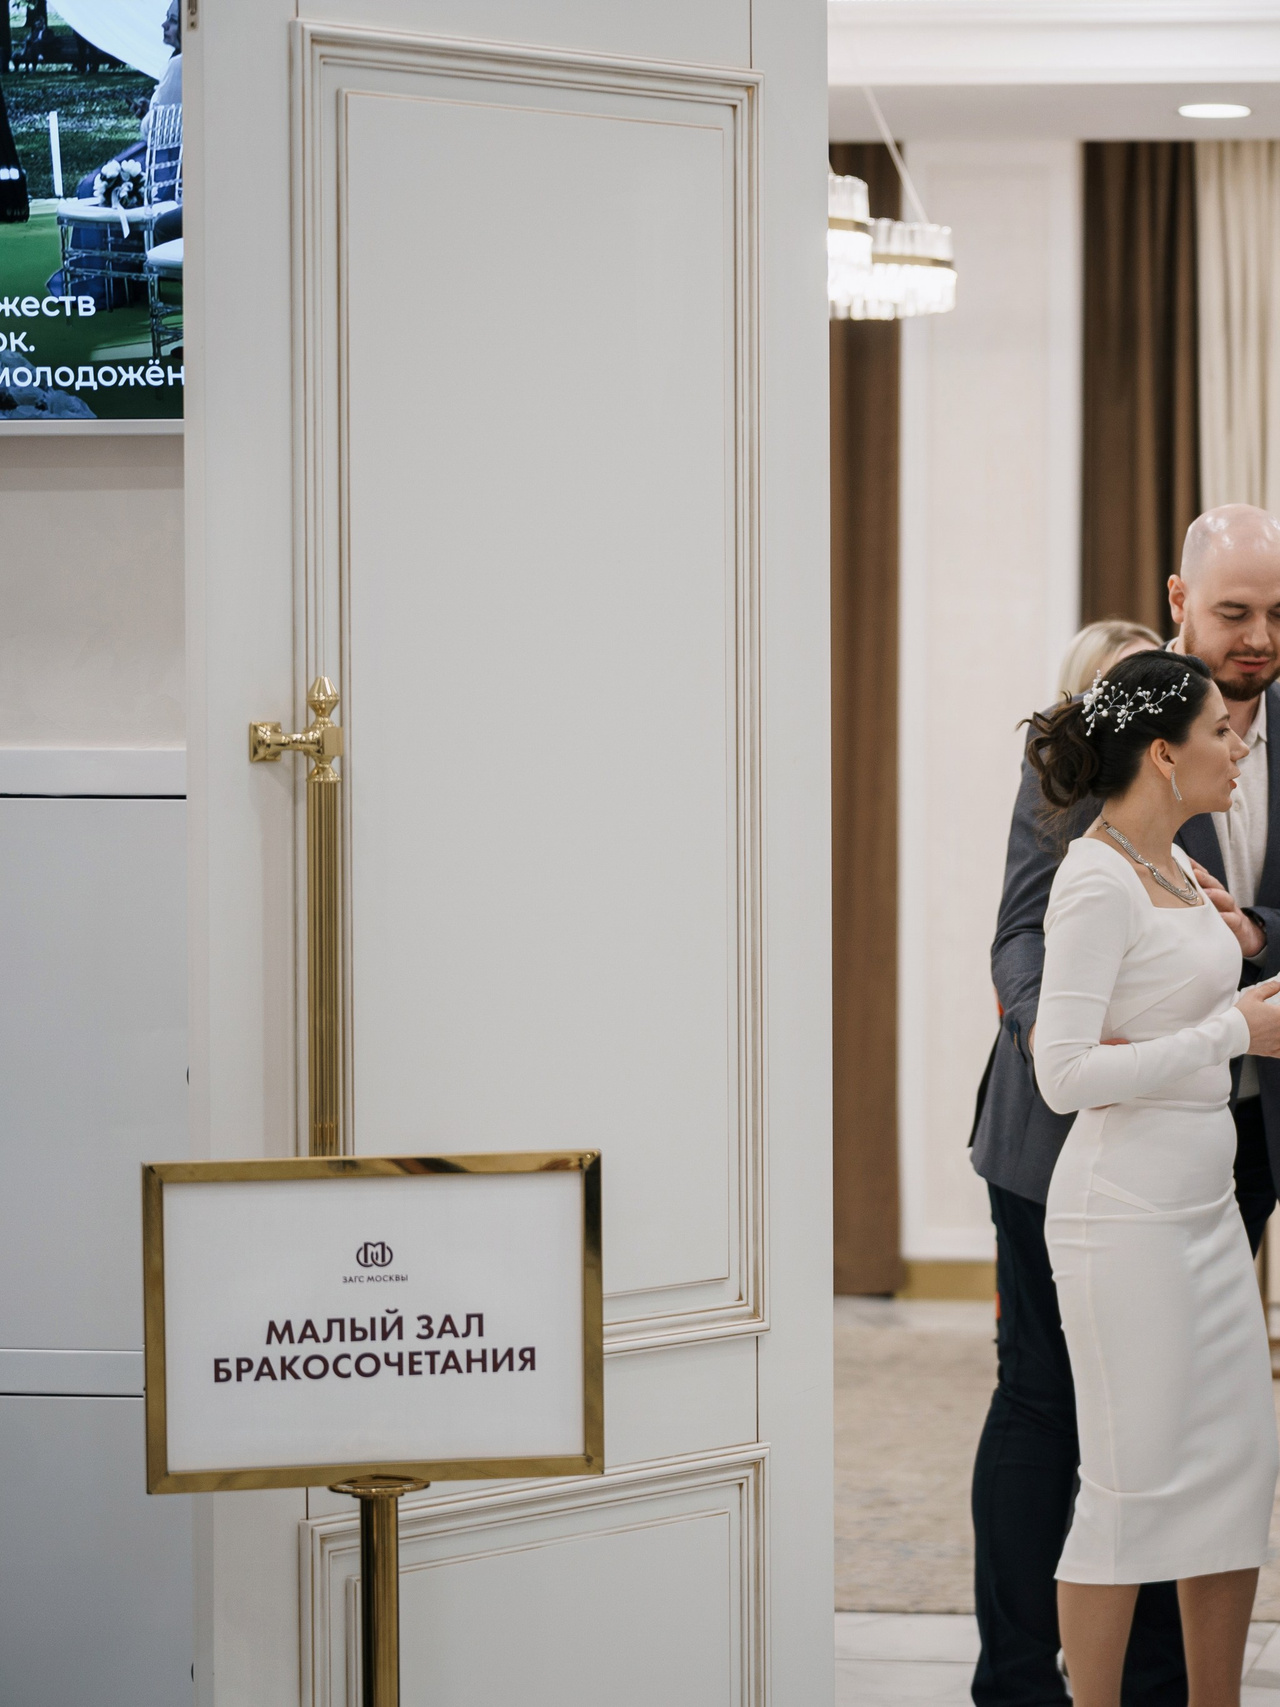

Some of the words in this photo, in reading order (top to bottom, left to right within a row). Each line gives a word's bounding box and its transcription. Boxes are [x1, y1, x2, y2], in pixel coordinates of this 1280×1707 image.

[342, 1275, 364, 1284] ЗАГС
[366, 1274, 409, 1283] МОСКВЫ
[265, 1308, 404, 1345] МАЛЫЙ
[415, 1313, 484, 1340] ЗАЛ
[213, 1346, 536, 1383] БРАКОСОЧЕТАНИЯ
